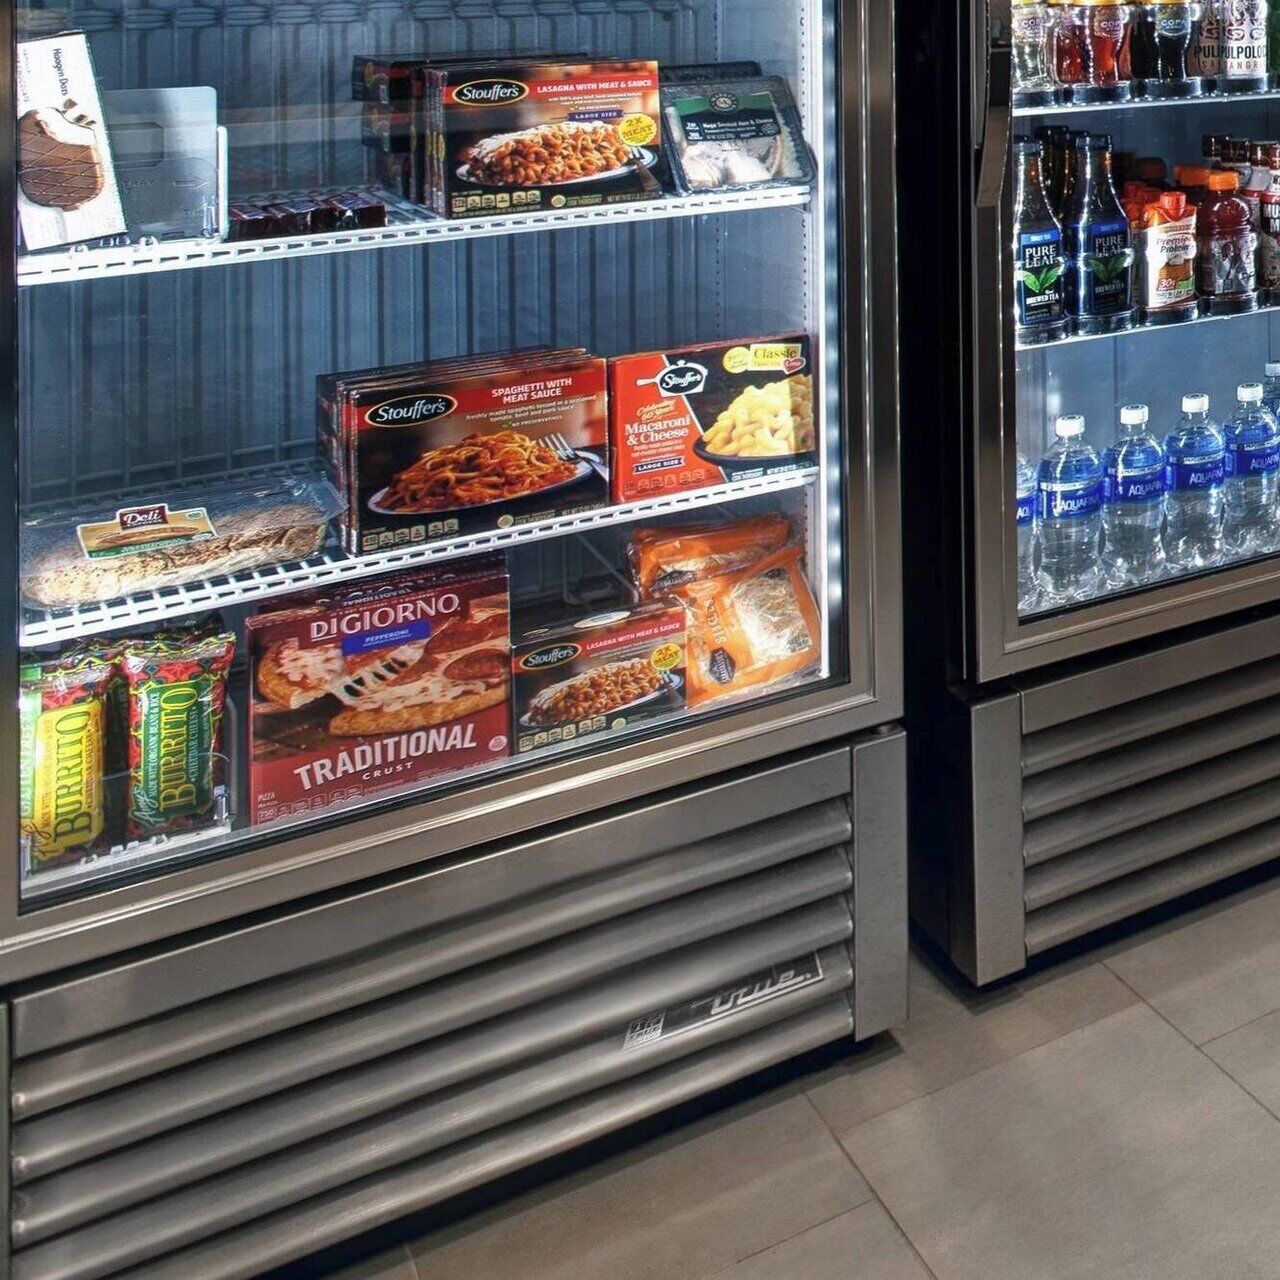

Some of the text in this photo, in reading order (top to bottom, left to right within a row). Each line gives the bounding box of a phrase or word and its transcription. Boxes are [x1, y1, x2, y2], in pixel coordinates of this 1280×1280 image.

[462, 84, 519, 101] Stouffer's
[537, 85, 574, 94] LASAGNA
[575, 83, 597, 92] WITH
[599, 82, 619, 90] MEAT
[628, 79, 652, 87] SAUCE
[623, 125, 653, 138] MEAT
[1095, 234, 1124, 248] PURE
[1025, 244, 1056, 258] PURE
[1026, 255, 1056, 269] LEAF
[1049, 292, 1060, 301] TEA
[754, 347, 797, 359] Classic
[492, 377, 573, 398] SPAGHETTI WITH
[662, 372, 701, 388] Stouffer's
[503, 387, 562, 404] MEAT SAUCE
[376, 398, 446, 422] Stouffer's
[624, 415, 690, 436] Macaroni
[626, 428, 690, 446] & Cheese
[124, 510, 161, 524] Deli
[365, 628, 410, 643] PEPPERONI
[528, 647, 574, 666] Stouffer's
[654, 651, 680, 665] MEAT
[159, 687, 198, 812] BURRITO
[294, 723, 477, 791] TRADITIONAL
[54, 710, 92, 842] BURRITO
[362, 762, 414, 781] CRUST
